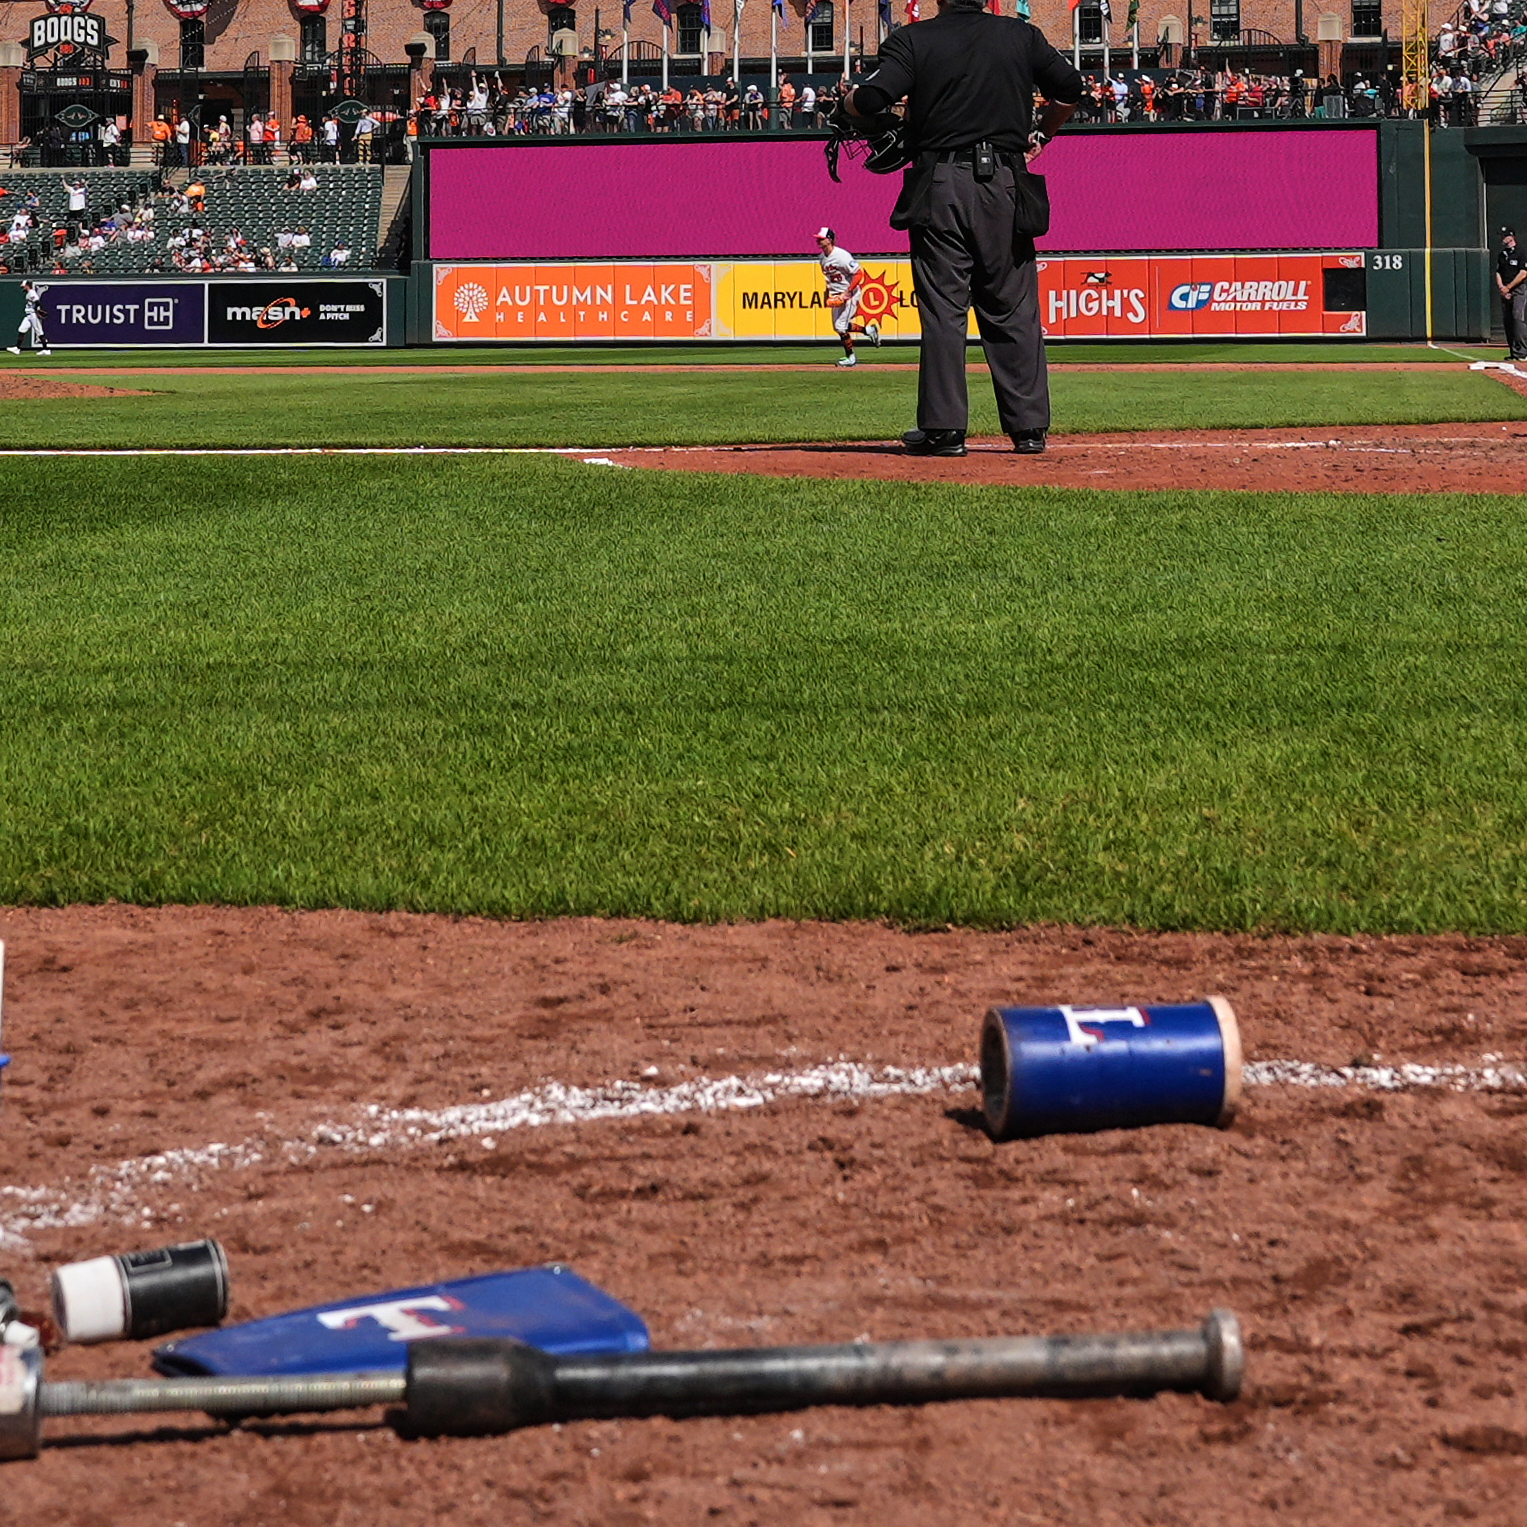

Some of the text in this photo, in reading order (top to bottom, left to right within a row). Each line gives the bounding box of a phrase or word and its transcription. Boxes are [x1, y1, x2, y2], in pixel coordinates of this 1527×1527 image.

[34, 15, 99, 48] BOOG'S
[1372, 255, 1402, 270] 318
[496, 283, 694, 307] AUTUMN LAKE
[742, 291, 829, 310] MARYLA
[1213, 281, 1310, 301] CARROLL
[56, 304, 139, 324] TRUIST
[1048, 287, 1146, 324] HIGH'S
[1211, 301, 1308, 312] MOTOR FUELS
[496, 310, 694, 322] HEALTHCARE
